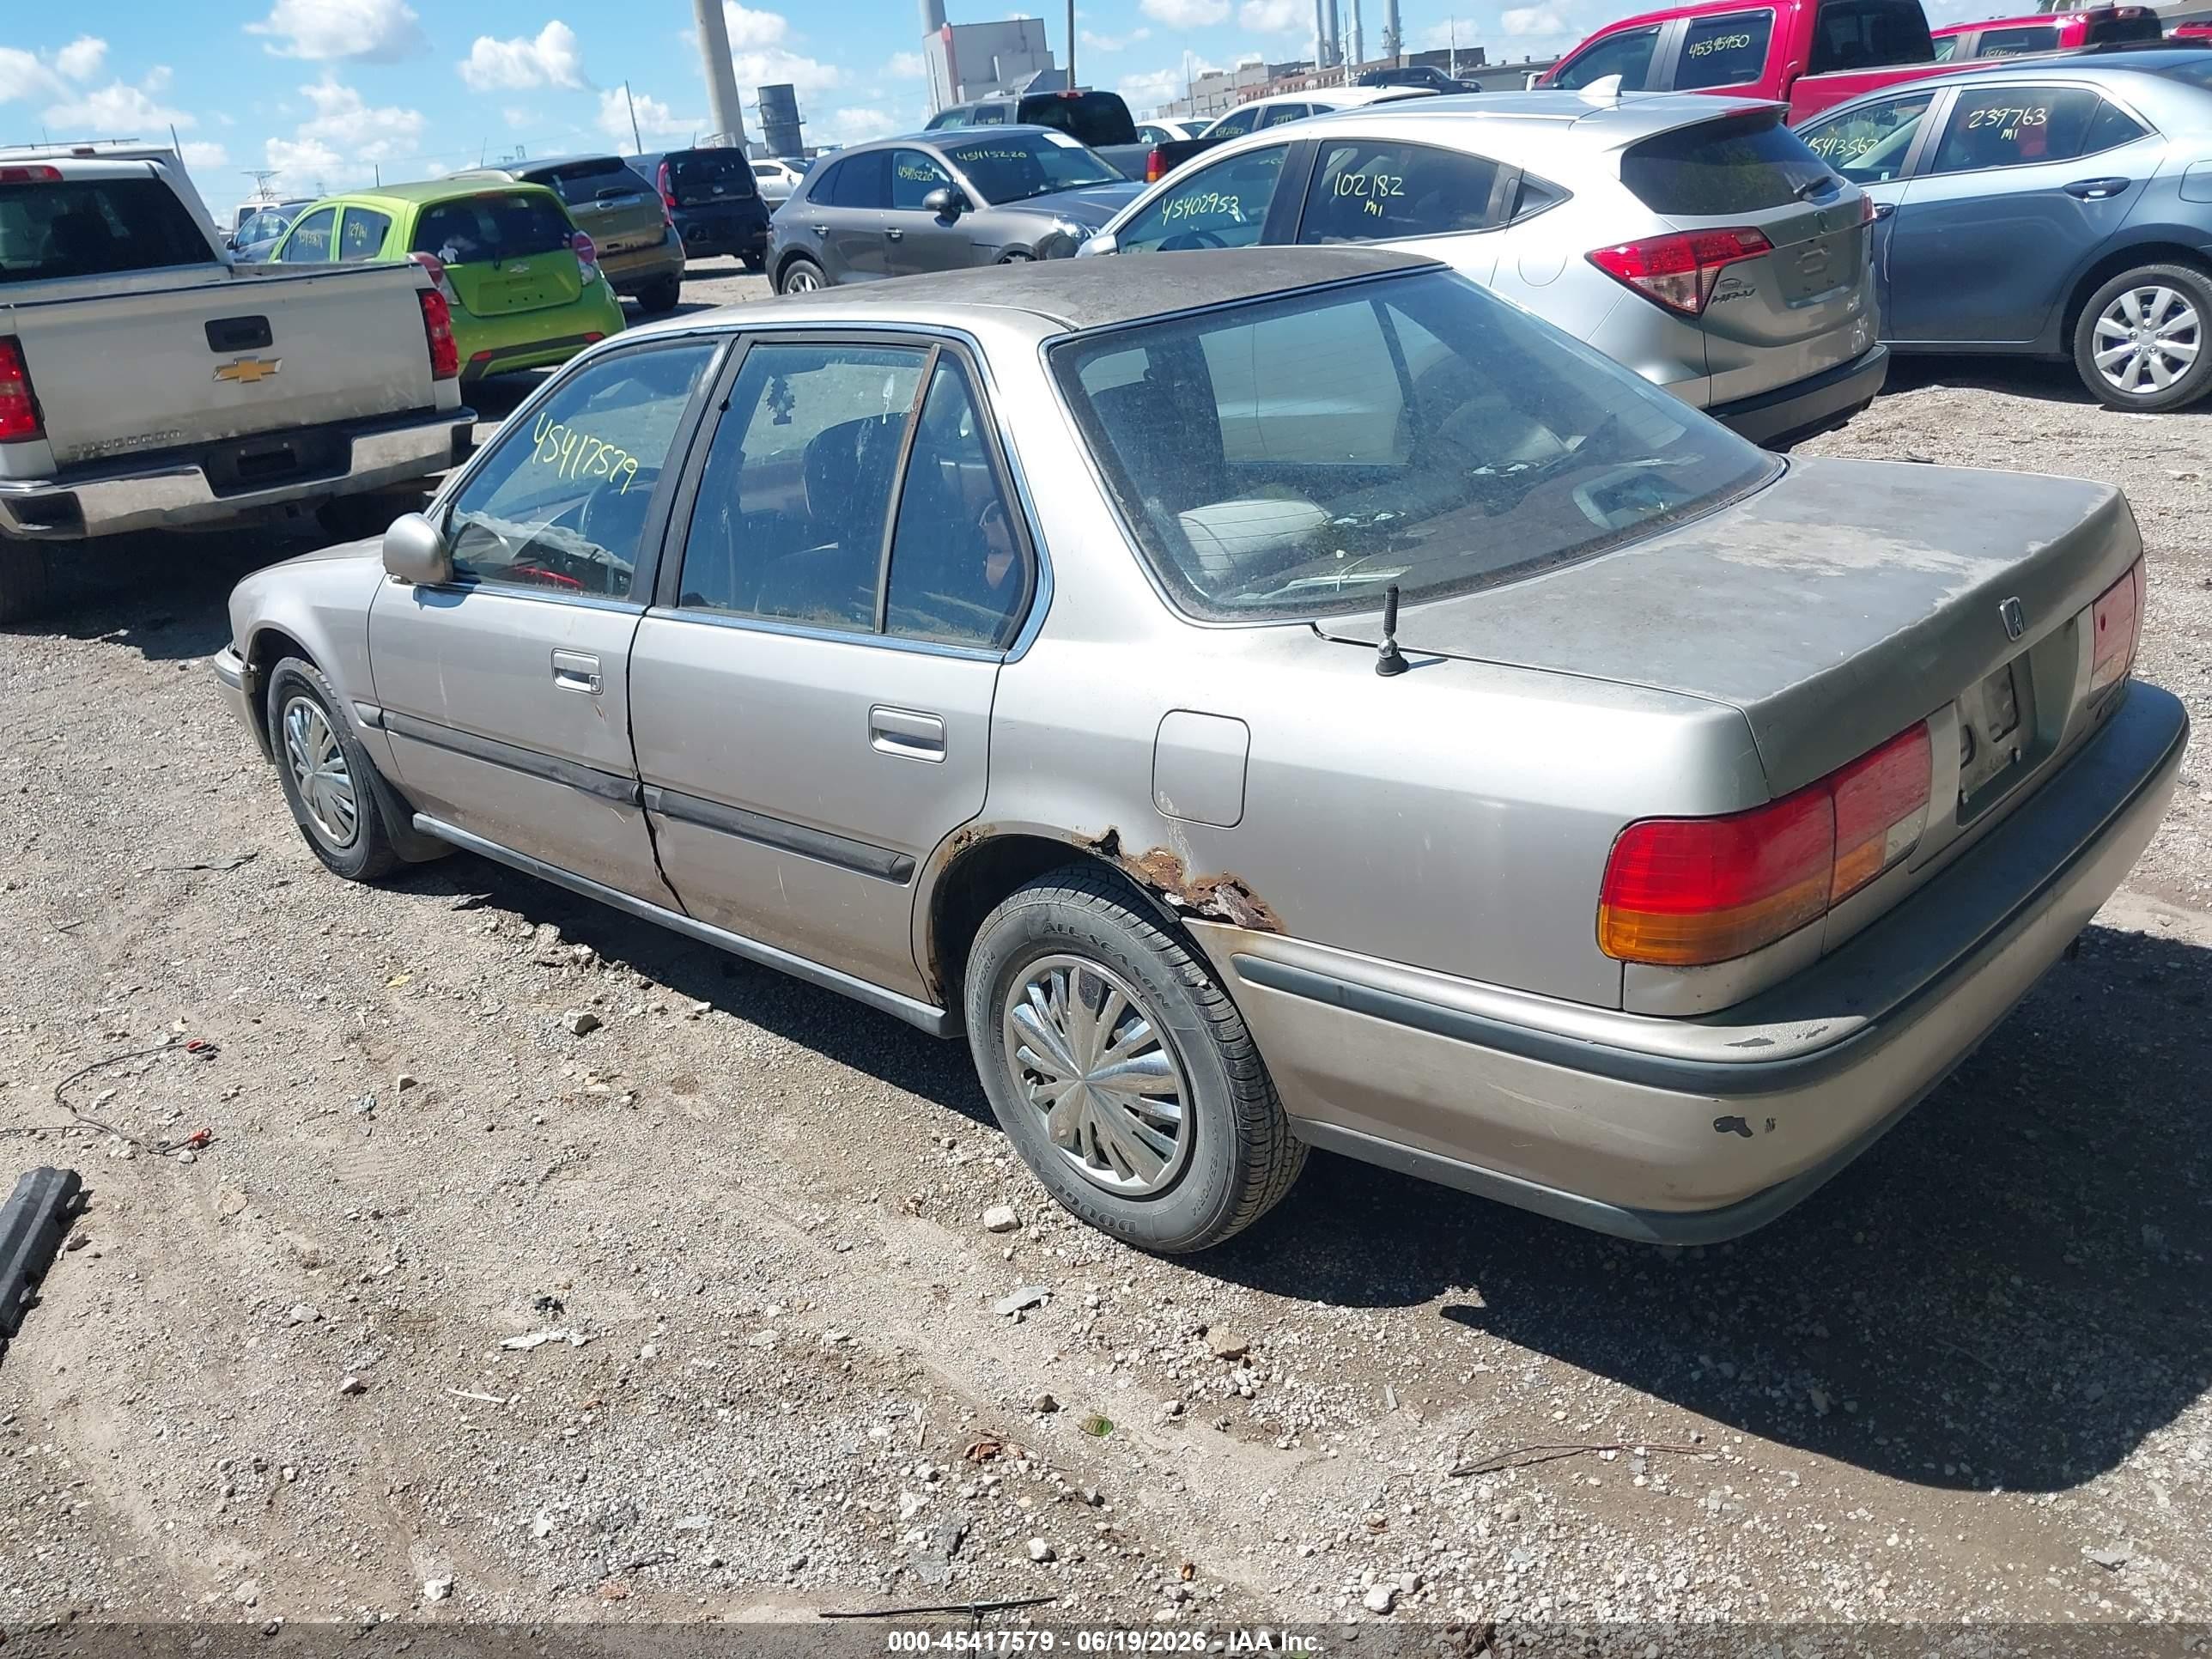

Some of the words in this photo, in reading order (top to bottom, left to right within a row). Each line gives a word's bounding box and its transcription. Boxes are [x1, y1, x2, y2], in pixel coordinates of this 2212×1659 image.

[1688, 34, 1750, 59] 45395950
[1968, 107, 2047, 129] 239763
[1334, 171, 1405, 199] 102182
[1162, 192, 1240, 226] 45402953
[532, 411, 639, 495] 45417579
